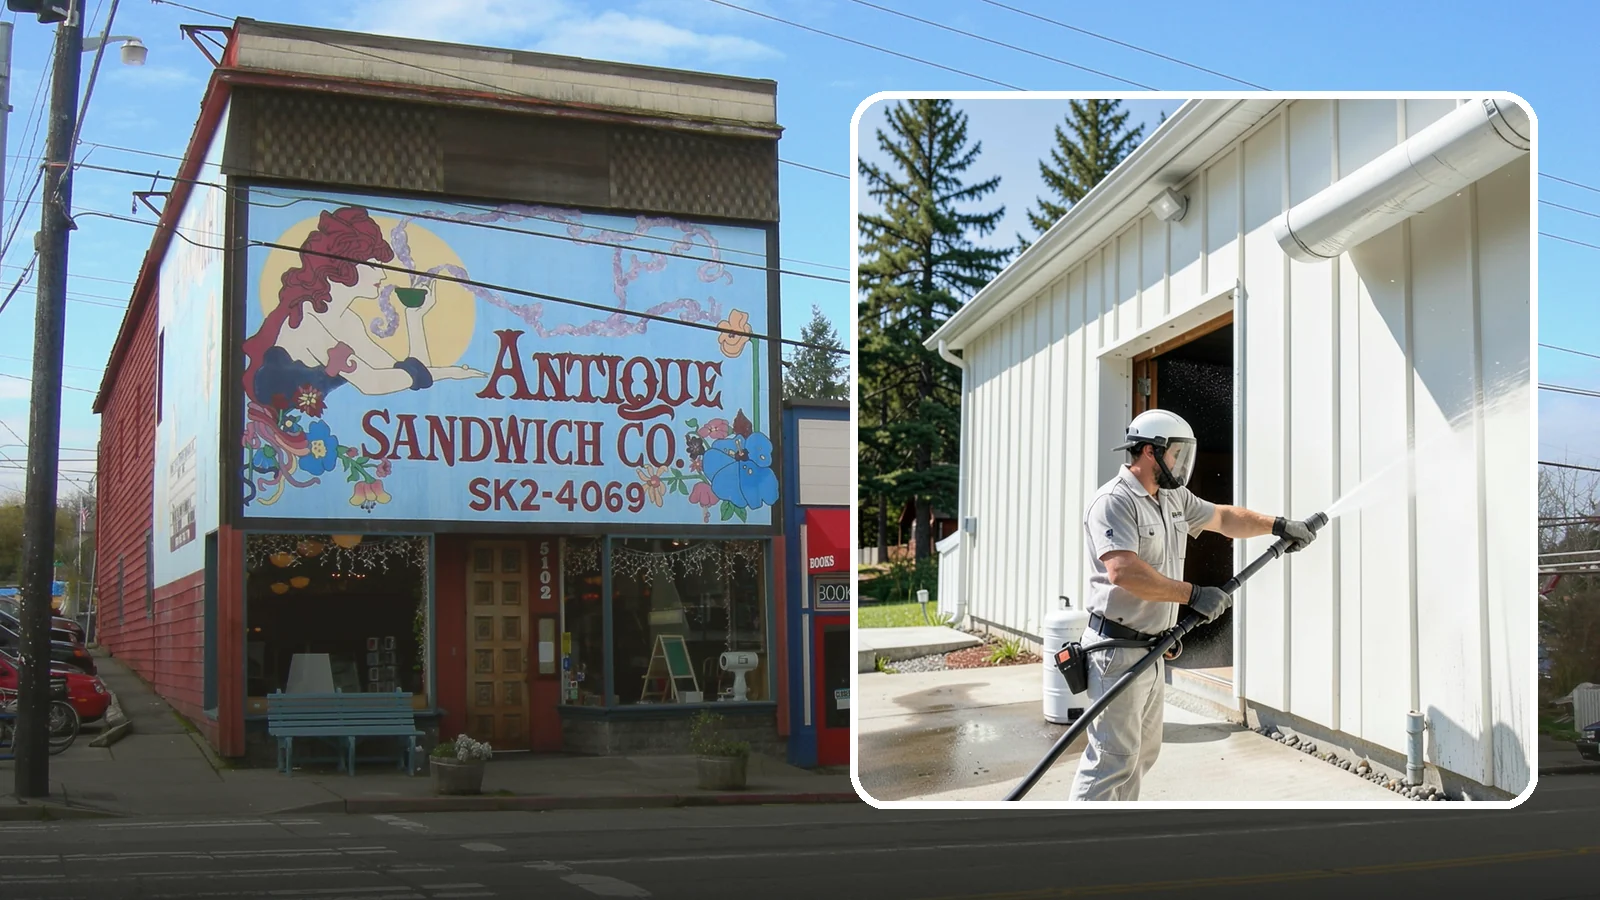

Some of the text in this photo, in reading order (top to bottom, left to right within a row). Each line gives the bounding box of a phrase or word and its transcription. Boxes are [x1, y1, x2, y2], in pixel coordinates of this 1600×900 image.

[476, 329, 724, 421] ANTIQUE
[361, 408, 686, 469] SANDWICH CO.
[468, 477, 646, 513] SK2-4069
[540, 541, 551, 600] 5102
[809, 555, 834, 568] BOOKS
